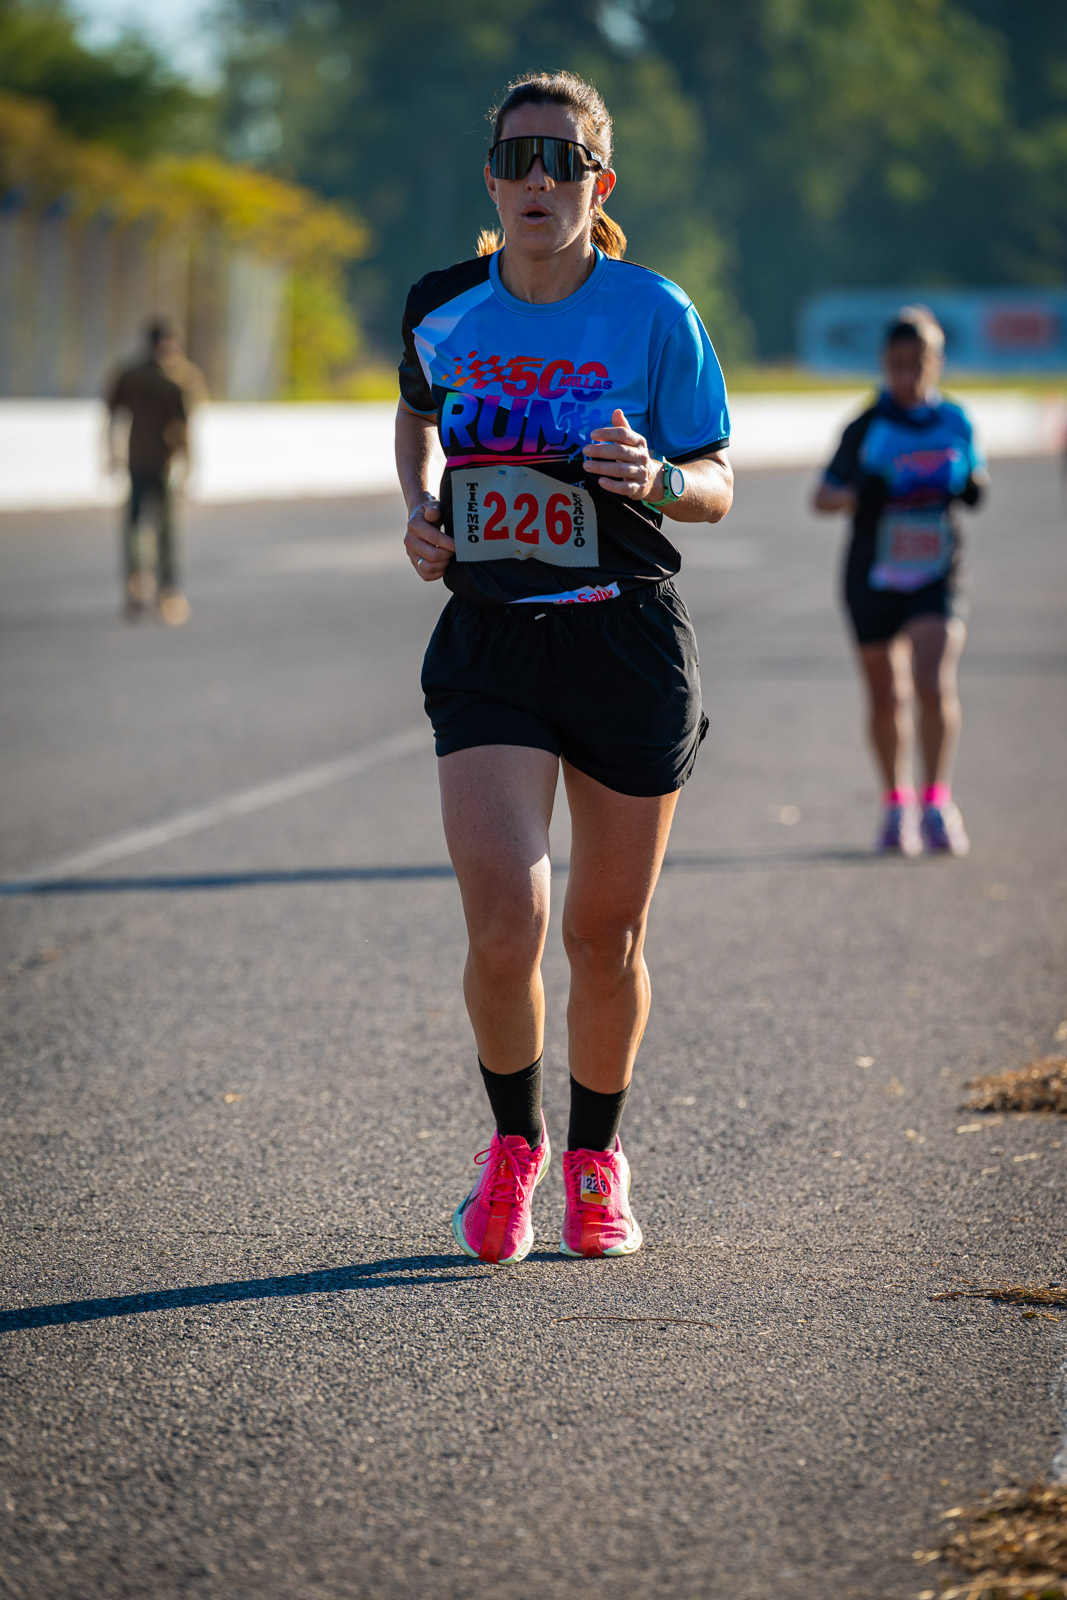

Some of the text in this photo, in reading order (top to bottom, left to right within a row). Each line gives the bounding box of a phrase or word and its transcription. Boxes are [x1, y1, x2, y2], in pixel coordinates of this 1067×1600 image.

[502, 356, 608, 402] 500
[558, 375, 613, 390] MILLAS
[466, 482, 479, 543] TIEMPO
[483, 491, 572, 545] 226
[571, 492, 585, 548] EXACTO
